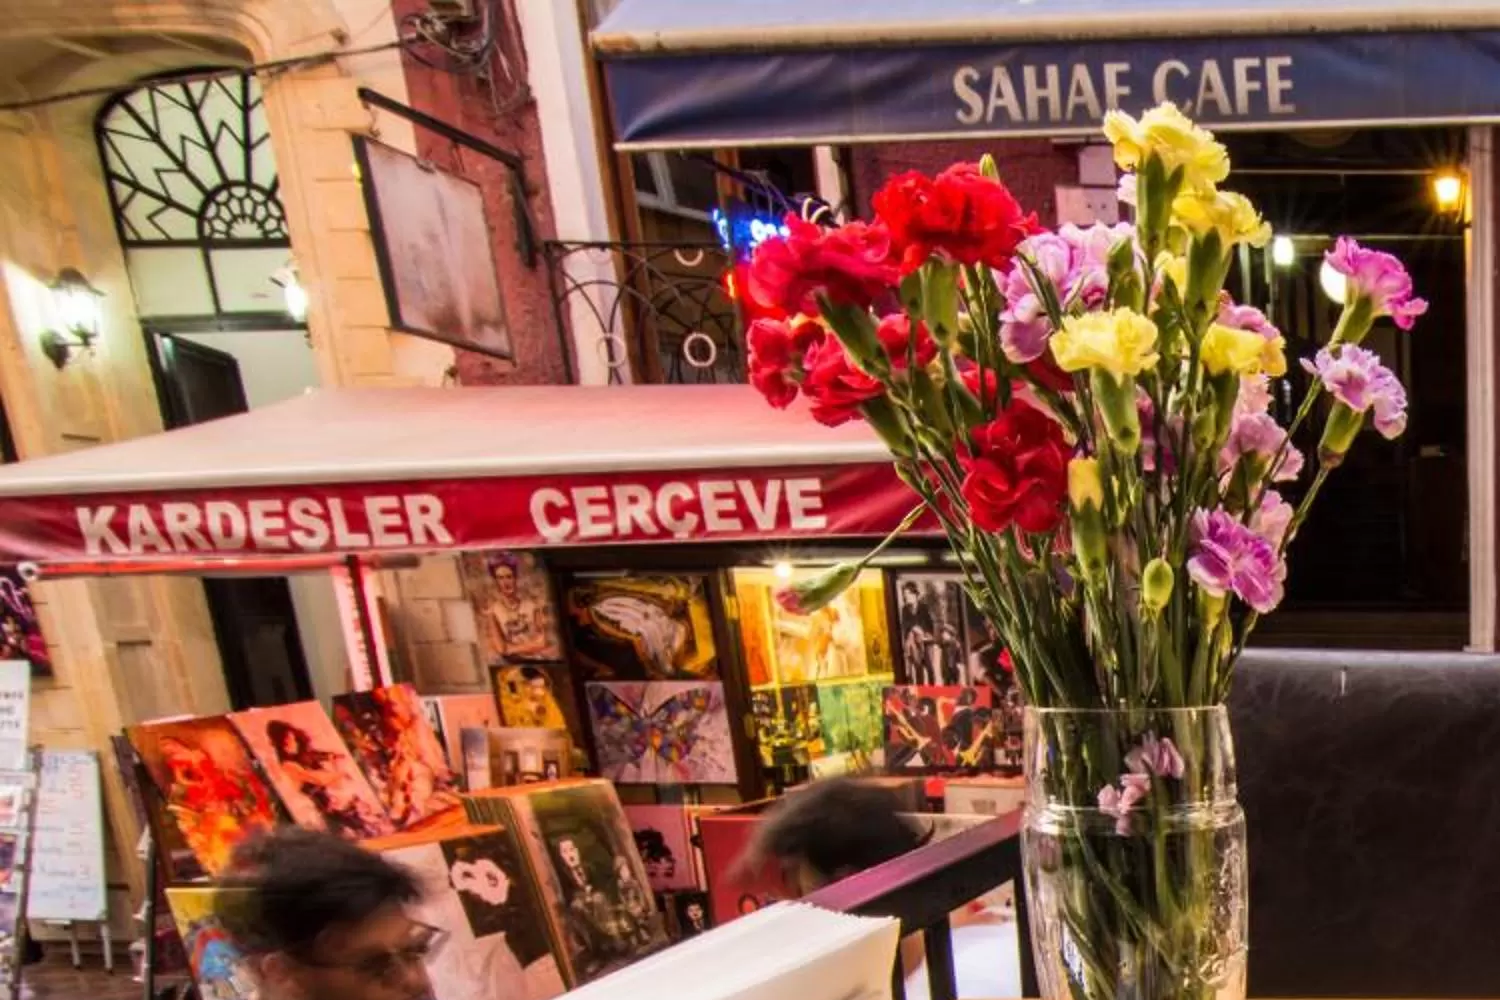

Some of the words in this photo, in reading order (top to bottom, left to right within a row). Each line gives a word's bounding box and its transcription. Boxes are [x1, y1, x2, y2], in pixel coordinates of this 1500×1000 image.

[953, 62, 1131, 125] SAHAF
[1151, 55, 1296, 116] CAFE
[76, 494, 454, 556] KARDESLER
[529, 478, 828, 544] ÇERÇEVE
